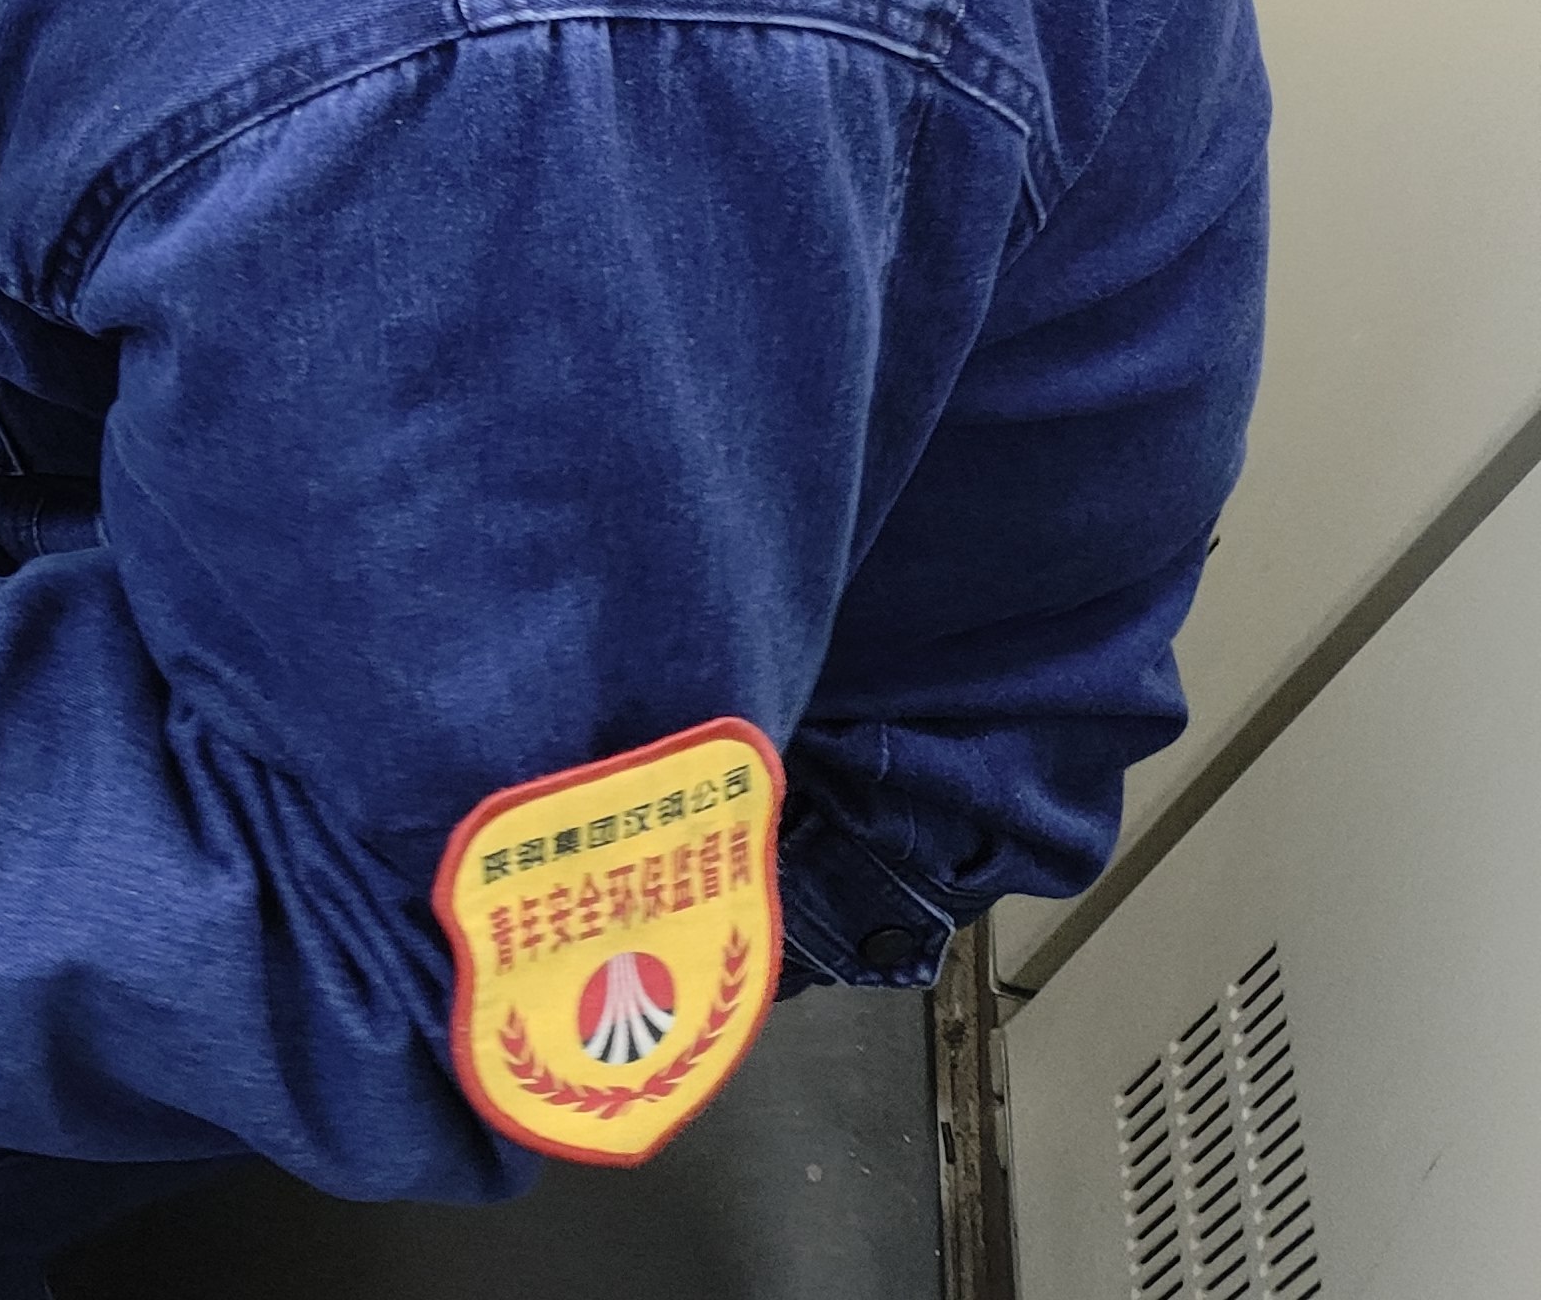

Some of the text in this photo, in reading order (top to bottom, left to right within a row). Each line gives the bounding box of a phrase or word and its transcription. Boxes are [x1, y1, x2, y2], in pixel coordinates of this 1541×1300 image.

[480, 764, 752, 886] 陕钢集团汉钢公司
